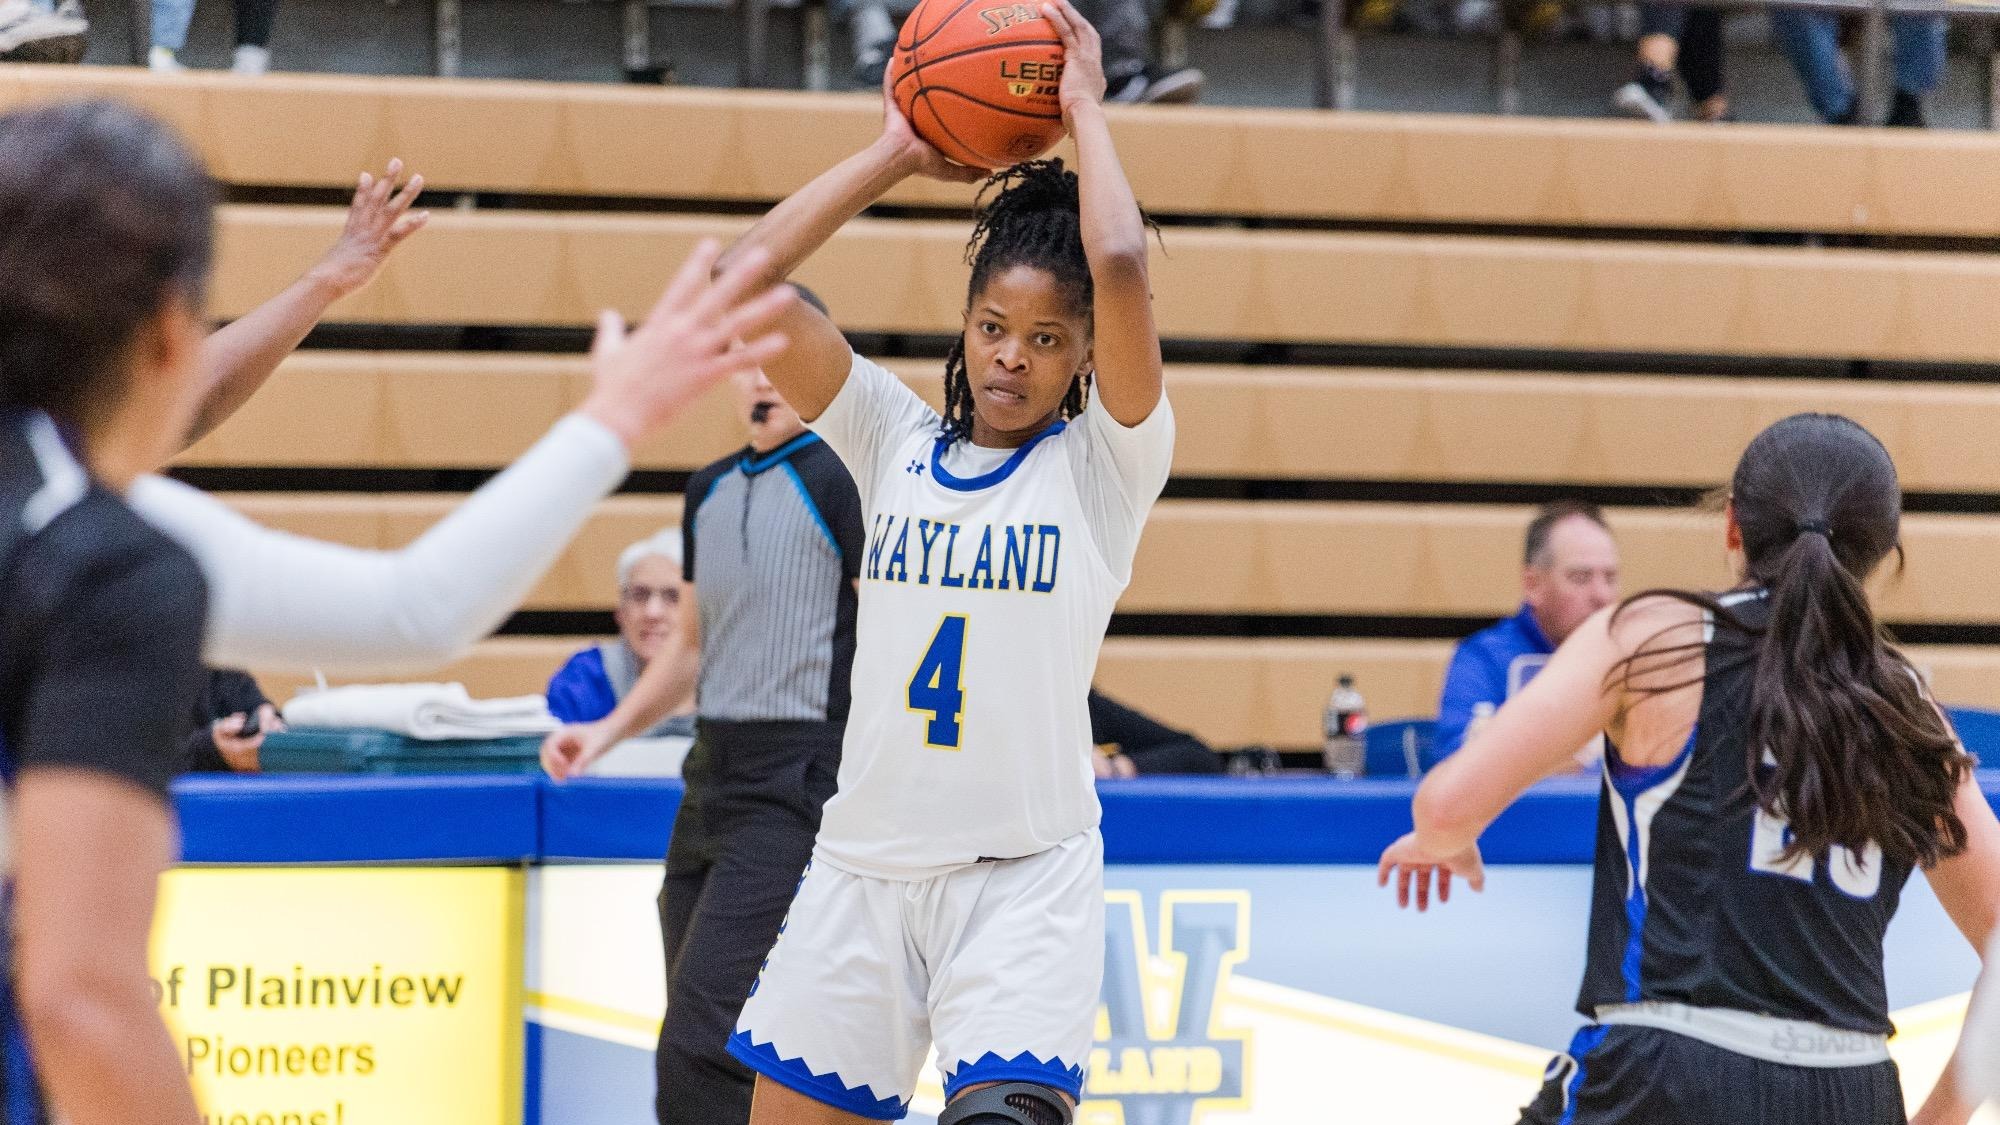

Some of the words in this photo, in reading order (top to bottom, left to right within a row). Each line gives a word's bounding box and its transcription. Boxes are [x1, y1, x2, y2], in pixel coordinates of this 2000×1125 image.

[867, 513, 1061, 593] WAYLAND
[905, 612, 970, 751] 4
[208, 966, 463, 1006] Plainview
[187, 1036, 375, 1075] Pioneers
[1087, 1047, 1222, 1094] LAND
